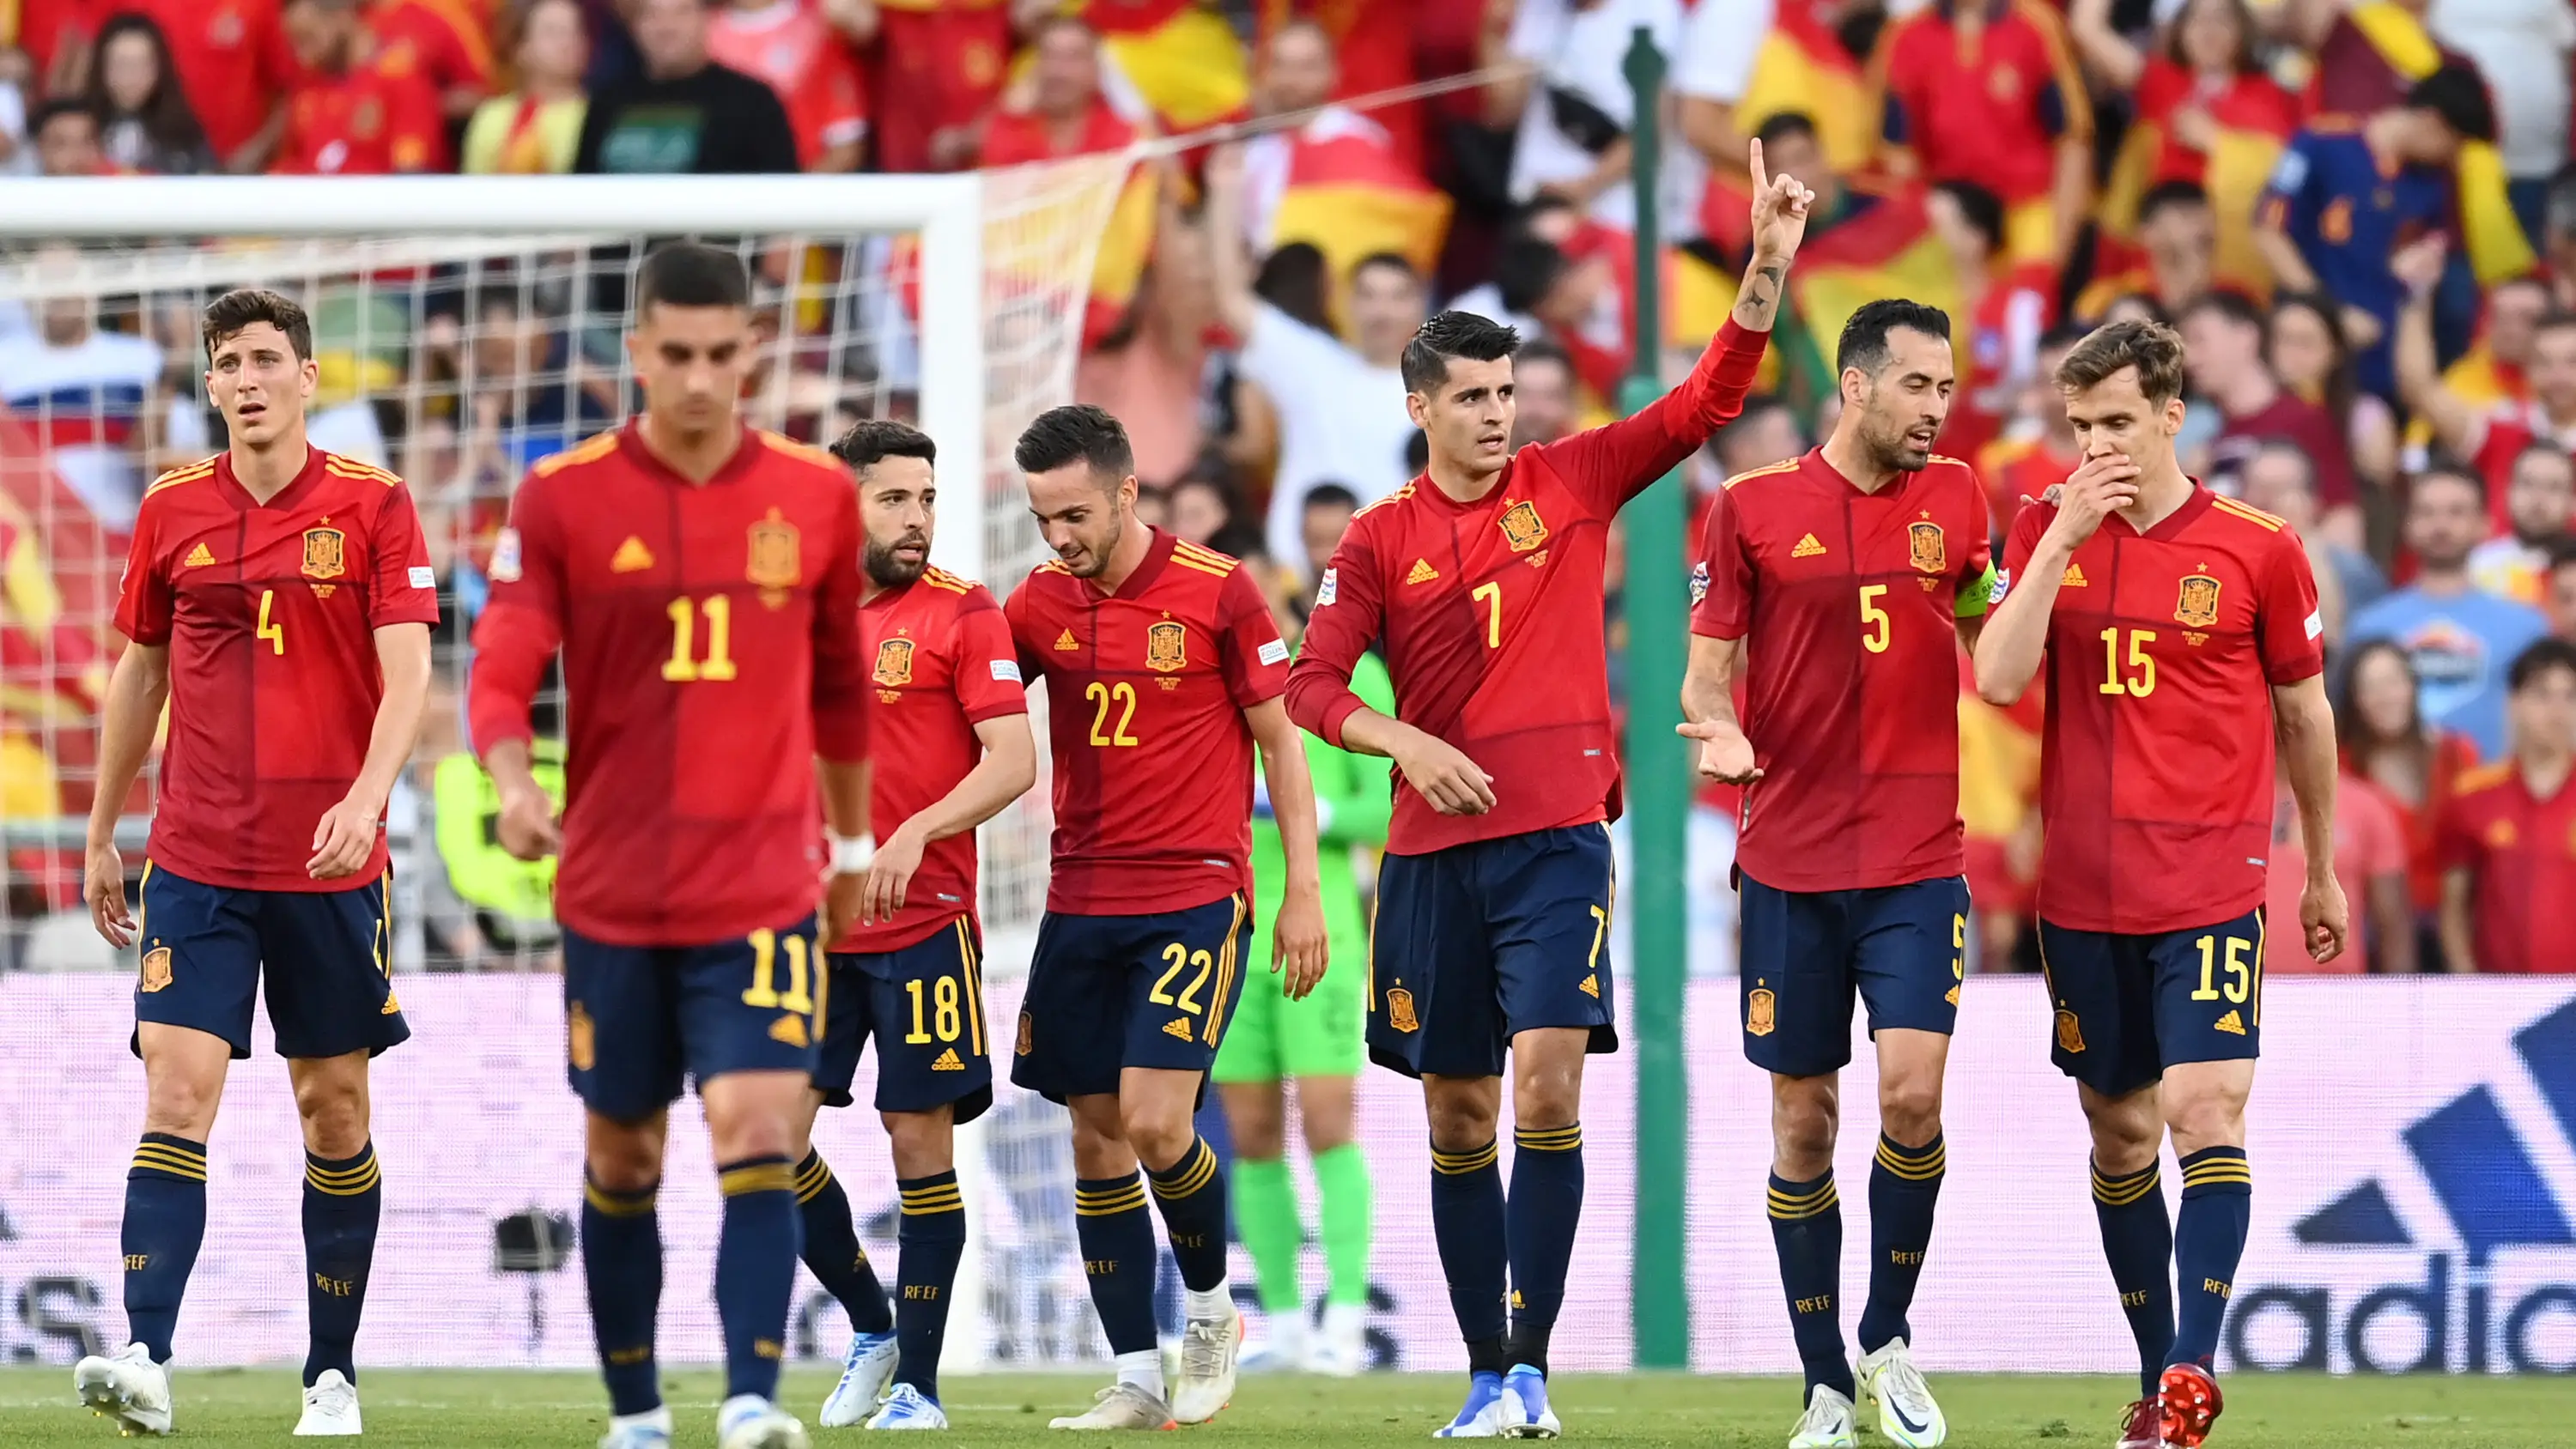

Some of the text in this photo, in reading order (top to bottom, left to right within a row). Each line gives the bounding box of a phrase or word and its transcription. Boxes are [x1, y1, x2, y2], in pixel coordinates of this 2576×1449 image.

[1406, 570, 1439, 585] adidas
[1791, 546, 1827, 558] adidas
[257, 590, 284, 655] 4
[661, 593, 738, 682] 11
[1472, 581, 1501, 648] 7
[1859, 584, 1890, 653] 5
[2099, 627, 2157, 697] 15
[1085, 682, 1139, 746] 22
[1589, 904, 1606, 968] 7
[1952, 915, 1965, 980] 5
[741, 927, 813, 1016] 11
[1149, 943, 1212, 1016] 22
[2191, 935, 2251, 1003] 15
[906, 975, 960, 1044] 18
[2214, 1022, 2246, 1036] adidas
[932, 1061, 965, 1071] adidas
[315, 1272, 354, 1297] RFEF
[1891, 1249, 1924, 1265] RFEF
[904, 1285, 939, 1300] RFEF
[1795, 1294, 1831, 1314] RFEF
